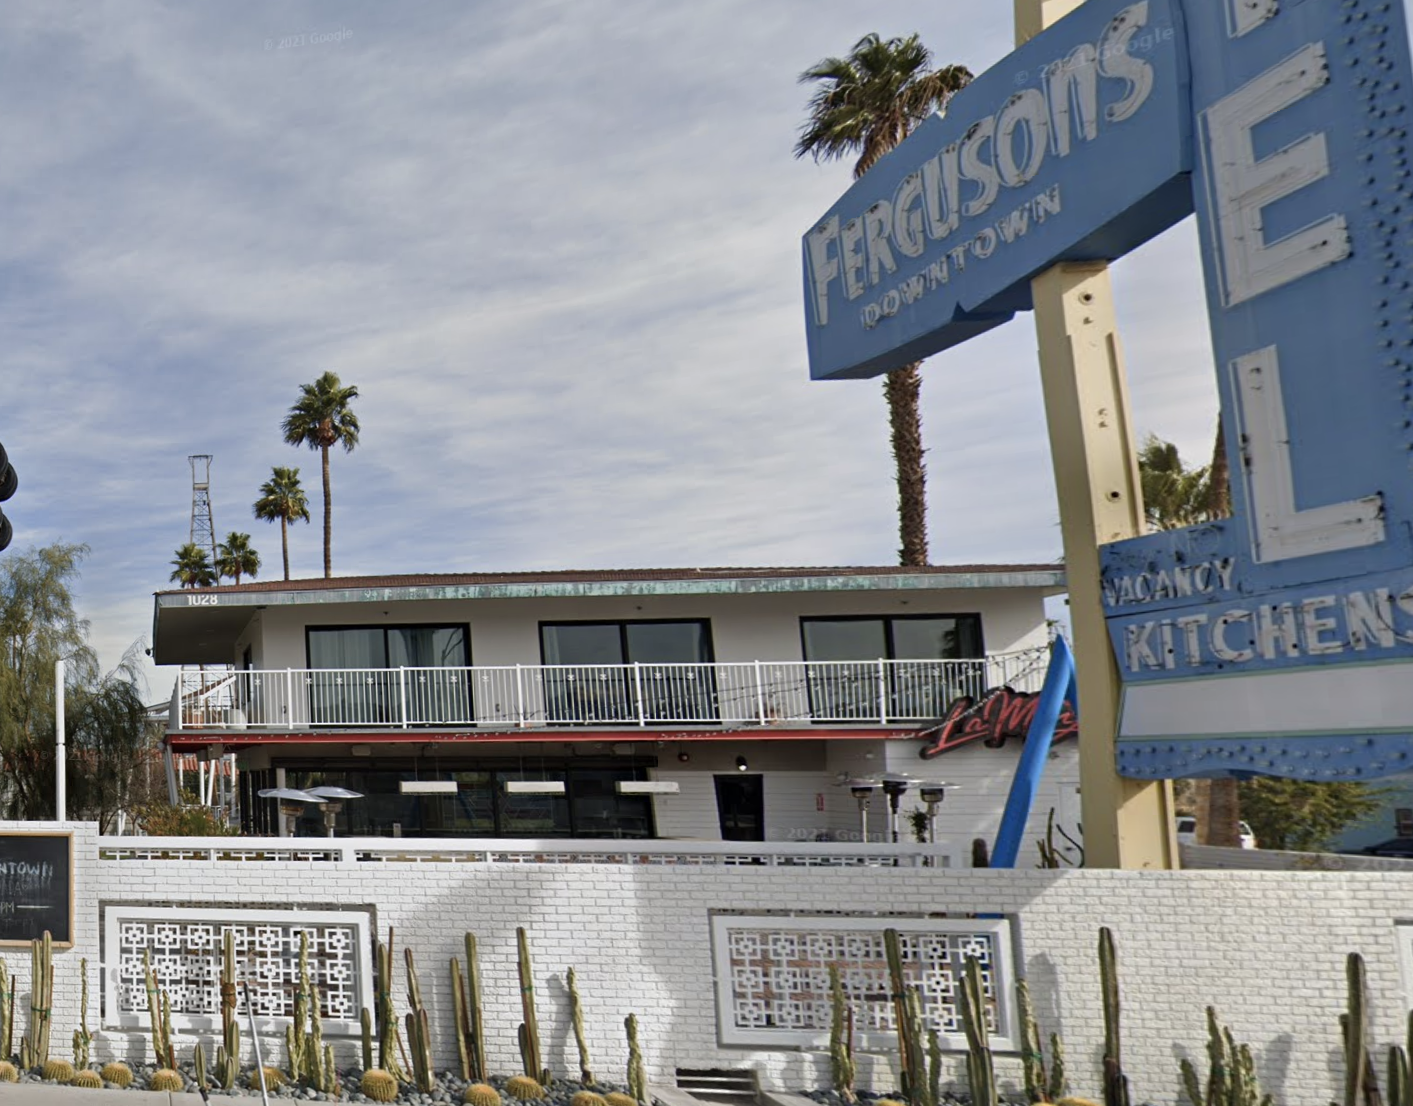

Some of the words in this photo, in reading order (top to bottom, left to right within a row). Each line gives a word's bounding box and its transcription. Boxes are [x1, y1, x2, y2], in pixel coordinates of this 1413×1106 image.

[859, 183, 1062, 329] DOWNTOWN
[187, 594, 219, 606] 1028
[1102, 557, 1236, 607] VACANCY
